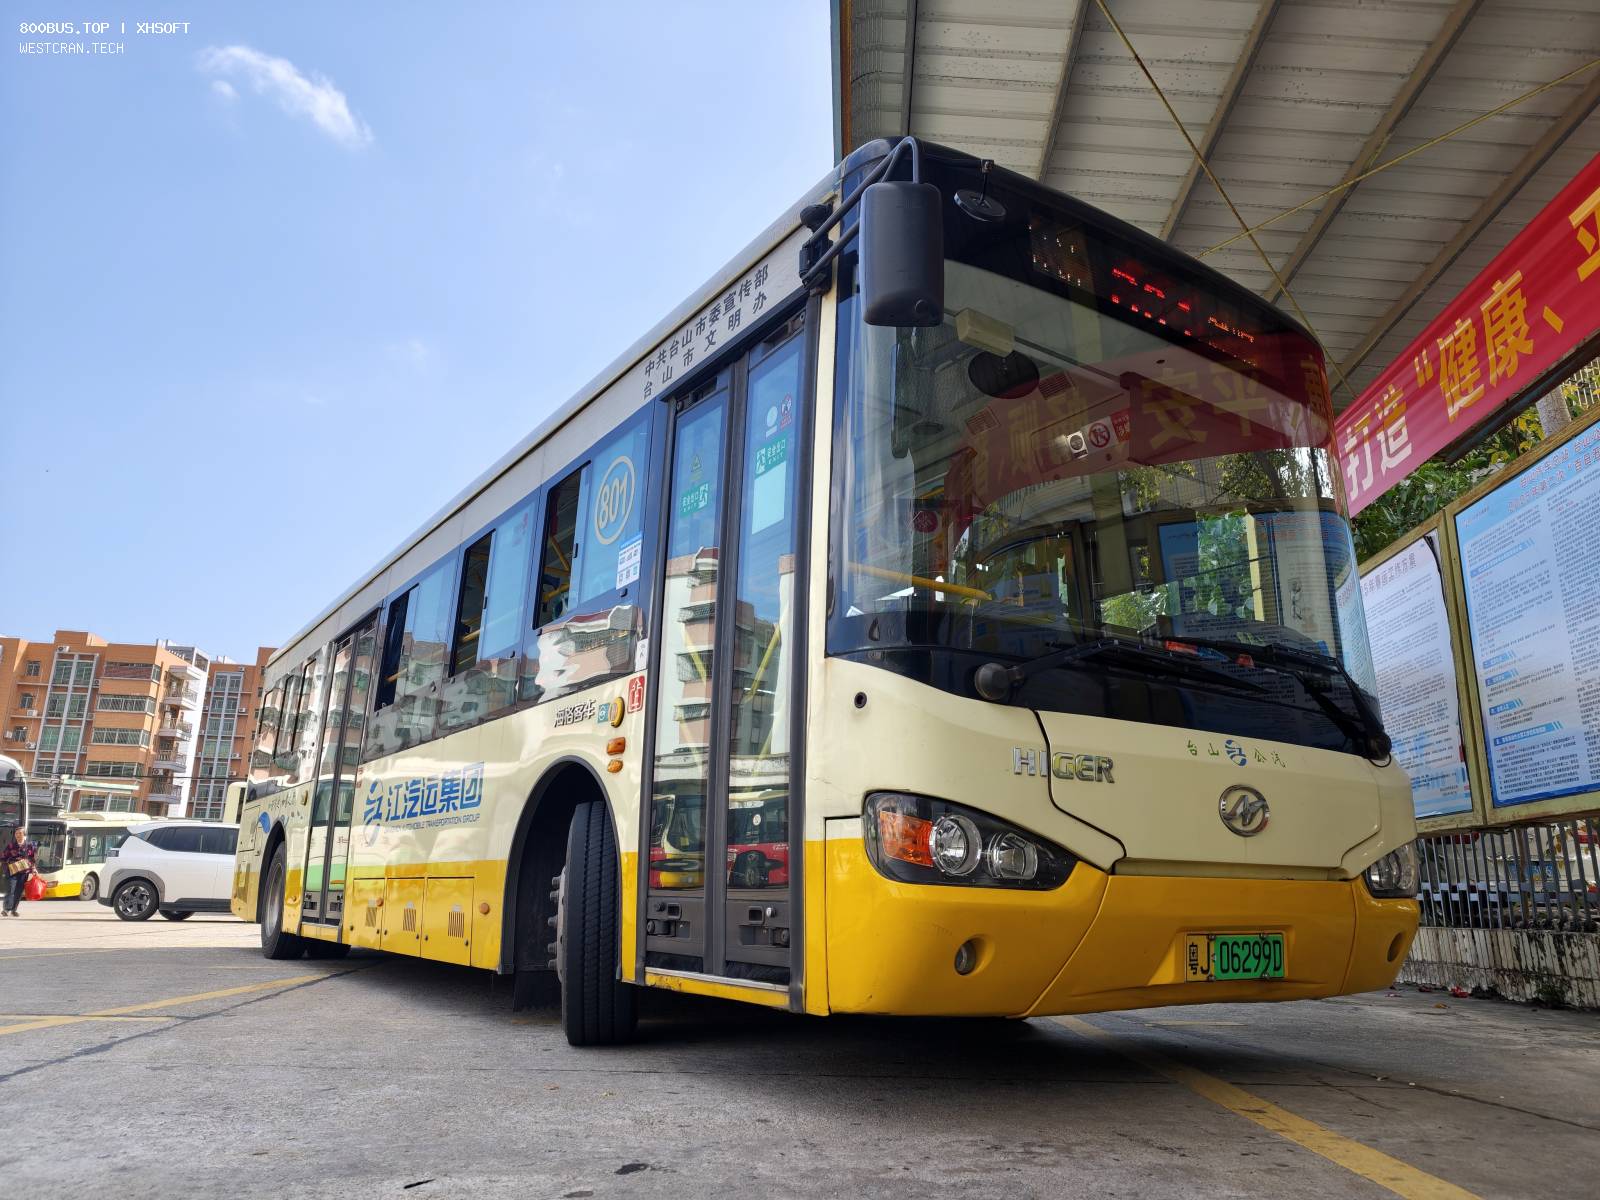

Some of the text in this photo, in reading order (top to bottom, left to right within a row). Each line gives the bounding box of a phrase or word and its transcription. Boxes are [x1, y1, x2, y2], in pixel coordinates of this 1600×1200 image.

[643, 291, 767, 399] 台山市文明办
[644, 263, 769, 378] 中共台山市委宣传部
[600, 472, 629, 529] 801
[1012, 746, 1115, 784] HIGER
[1186, 739, 1220, 757] 台山
